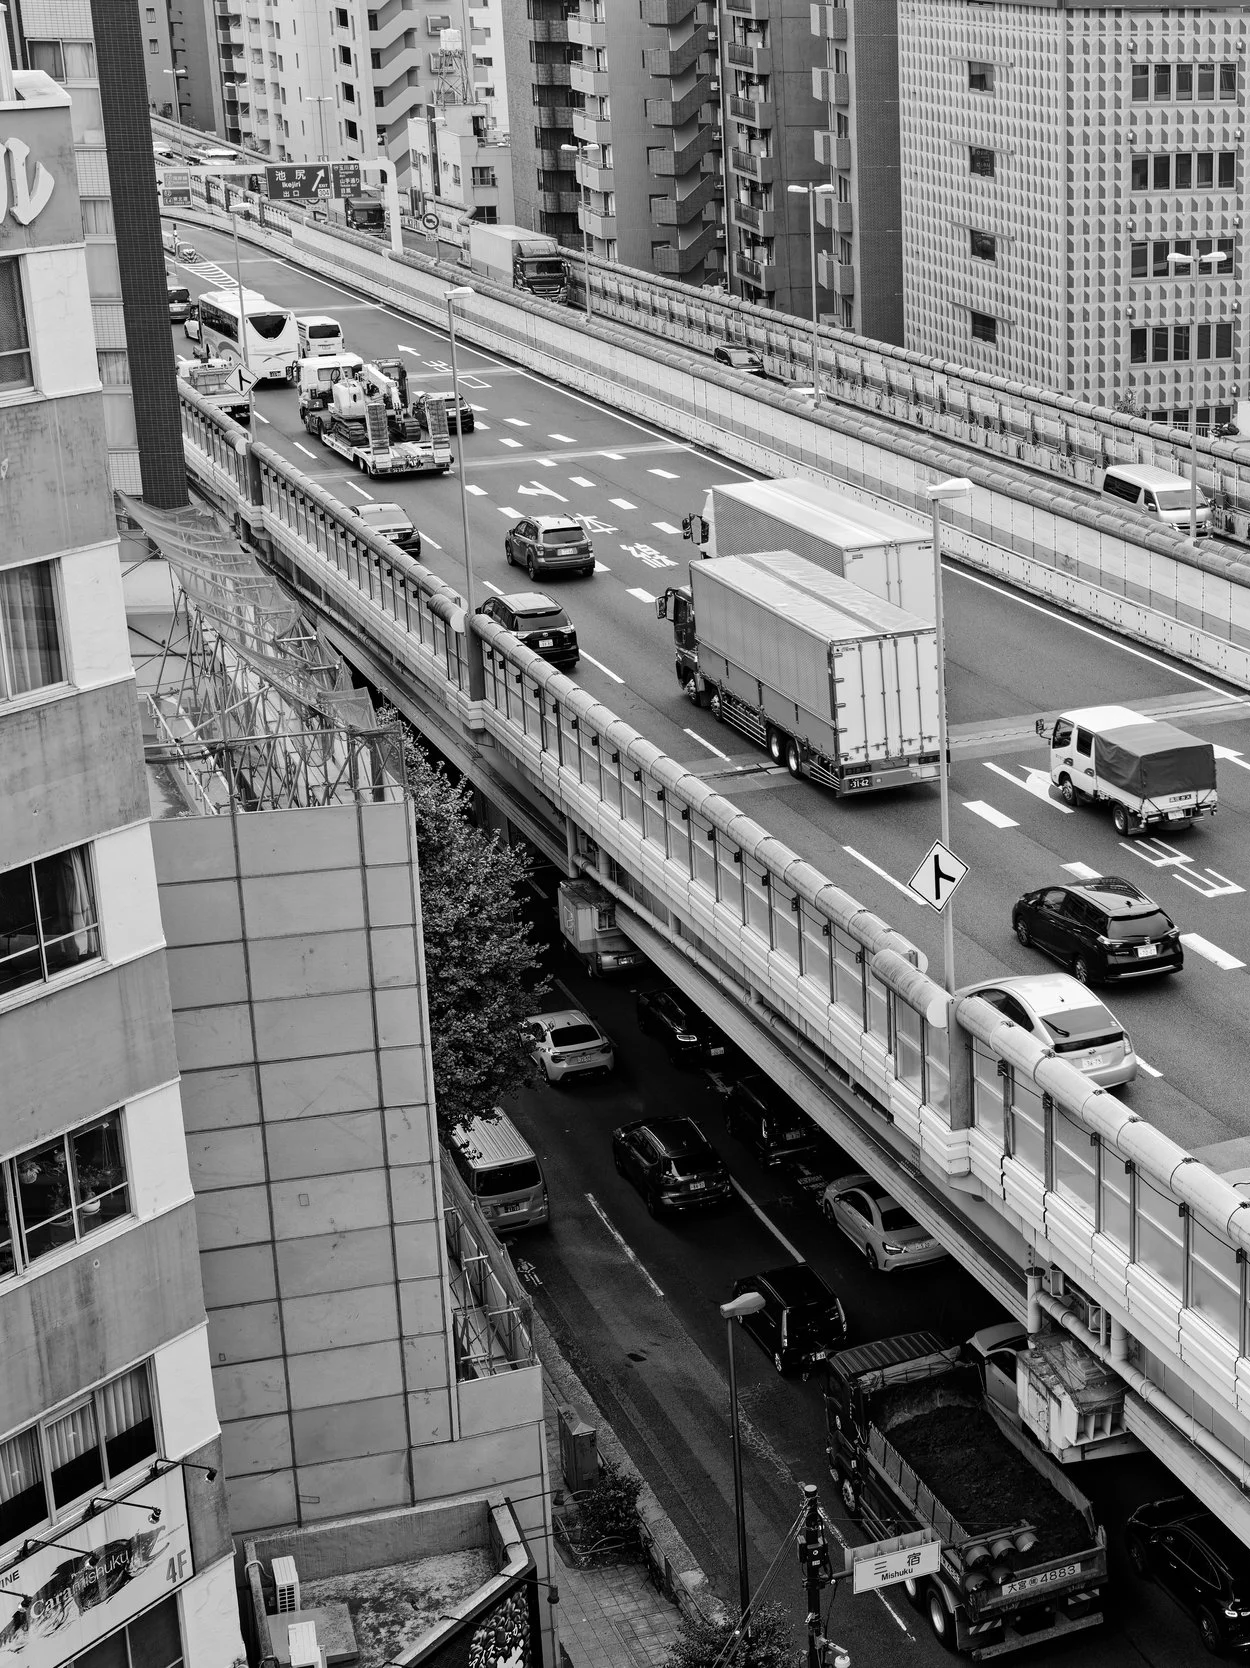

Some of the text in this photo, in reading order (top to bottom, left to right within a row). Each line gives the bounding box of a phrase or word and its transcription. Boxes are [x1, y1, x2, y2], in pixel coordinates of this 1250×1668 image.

[275, 169, 306, 181] 池尻
[281, 181, 301, 189] Ikejiri
[165, 1549, 187, 1584] 4F
[873, 1551, 921, 1575] 三宿
[0, 1570, 20, 1588] INE
[881, 1567, 914, 1581] Mishuku
[1008, 1580, 1027, 1594] 大宮
[1040, 1565, 1076, 1583] 4883
